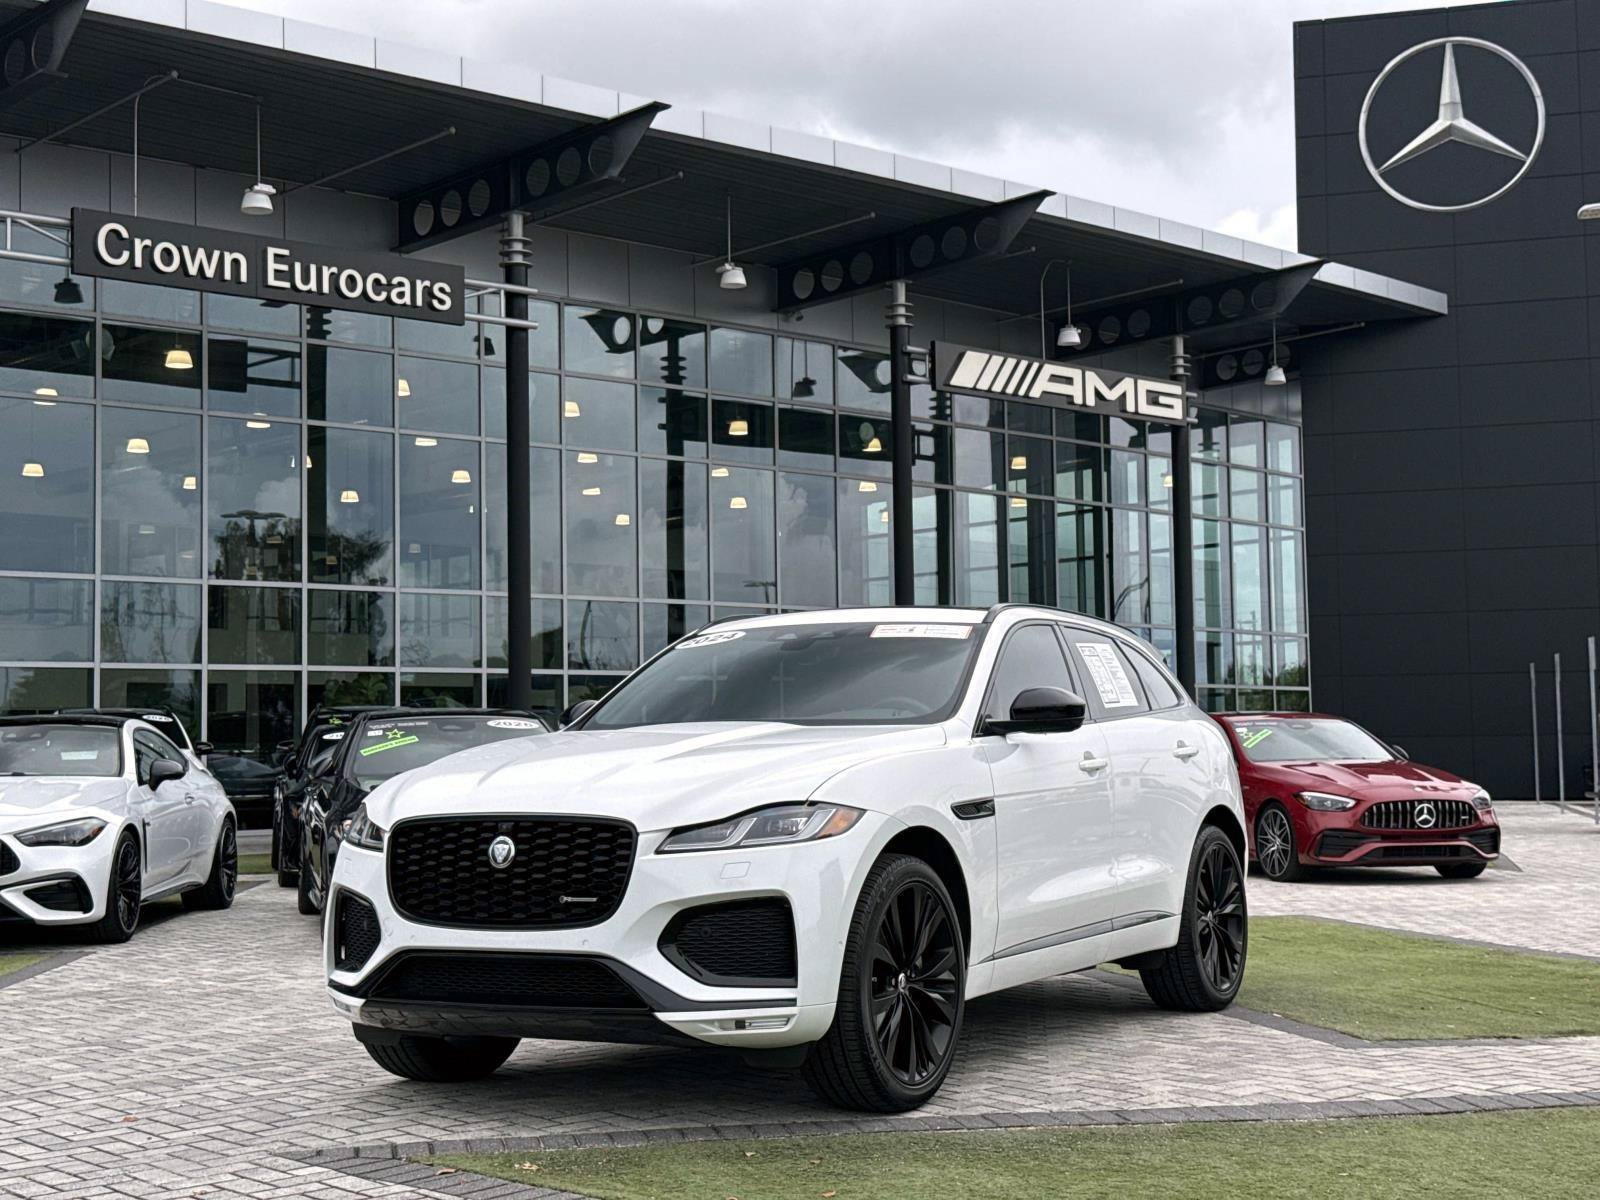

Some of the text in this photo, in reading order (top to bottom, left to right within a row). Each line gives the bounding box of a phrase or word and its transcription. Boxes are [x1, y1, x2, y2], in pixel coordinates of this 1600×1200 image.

[96, 222, 453, 312] Crown Eurocars
[1028, 363, 1184, 420] AMG
